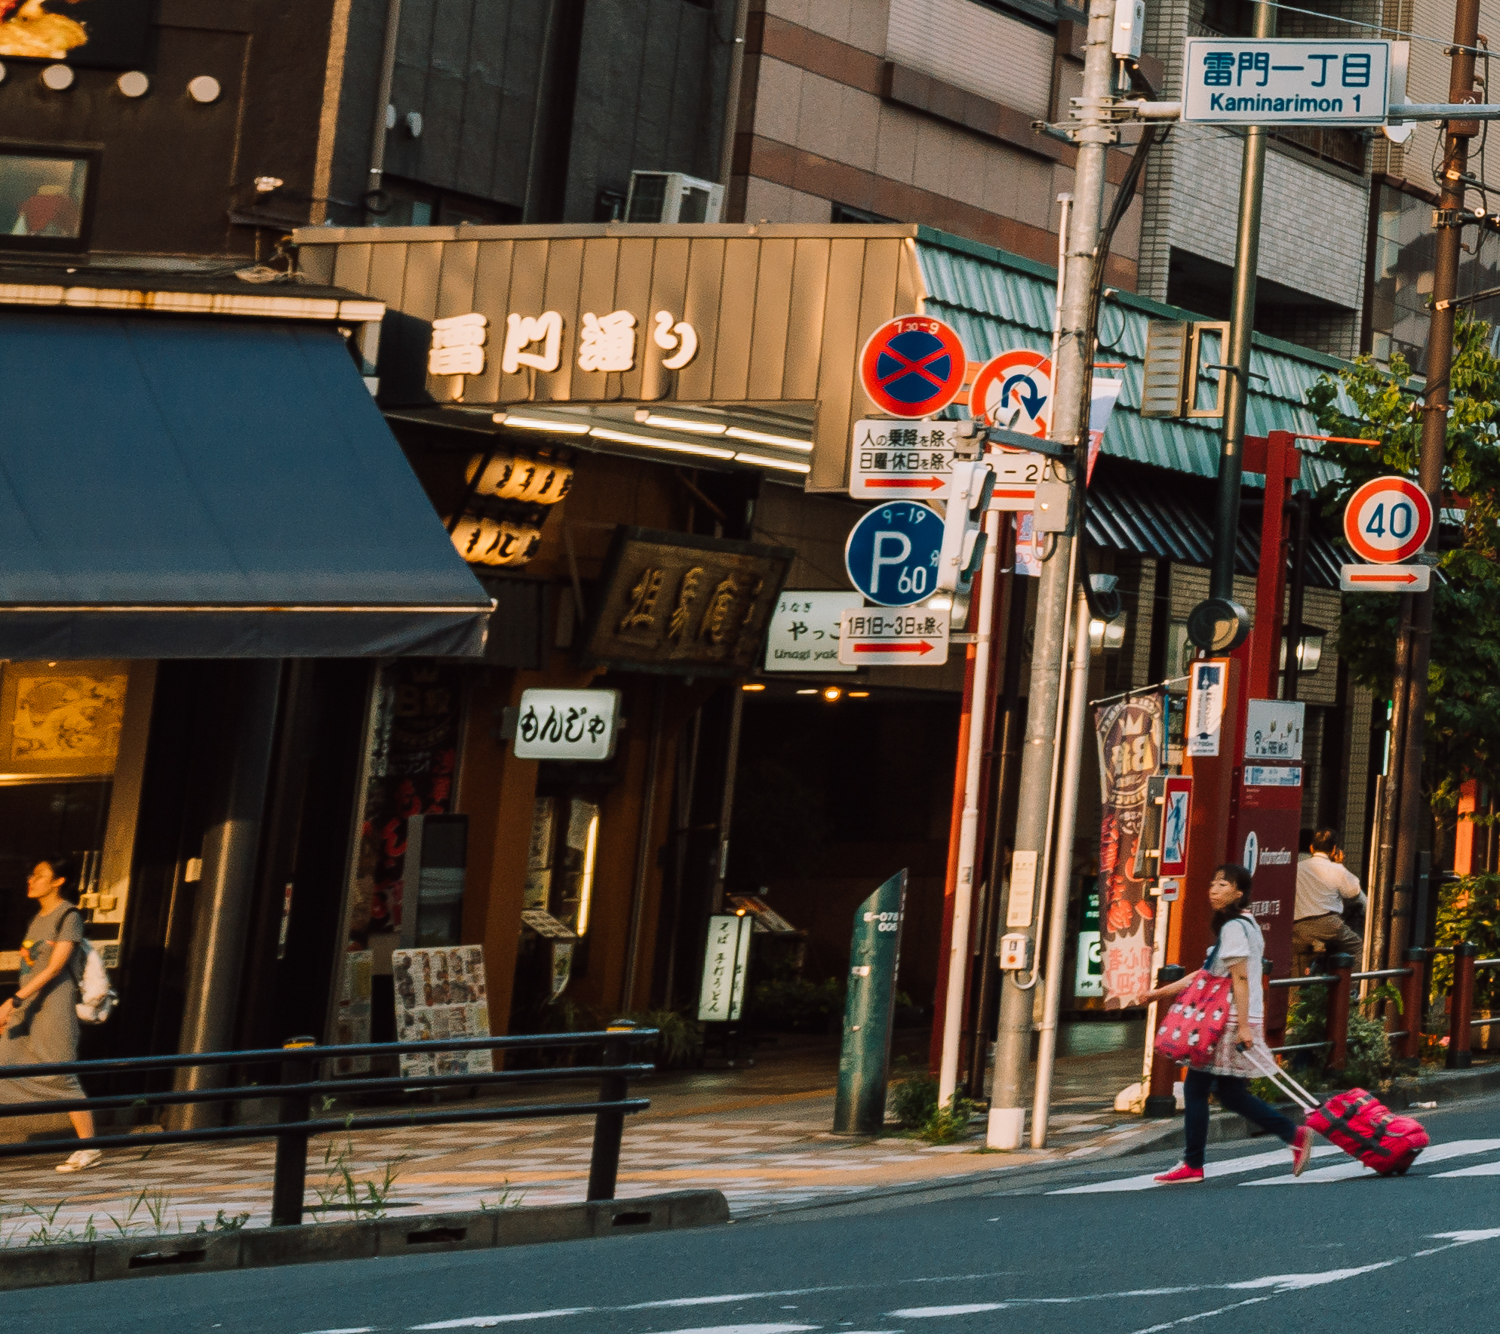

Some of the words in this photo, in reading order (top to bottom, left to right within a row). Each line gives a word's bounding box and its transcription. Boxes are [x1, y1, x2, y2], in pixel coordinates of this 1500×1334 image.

[1203, 51, 1372, 89] 雷門一丁目
[1209, 93, 1345, 115] Kaminarimon
[1353, 94, 1362, 114] 1
[428, 309, 698, 378] 雷門通り
[882, 509, 926, 525] 9-19
[1365, 502, 1413, 540] 40
[869, 530, 911, 595] P
[898, 566, 927, 594] 60
